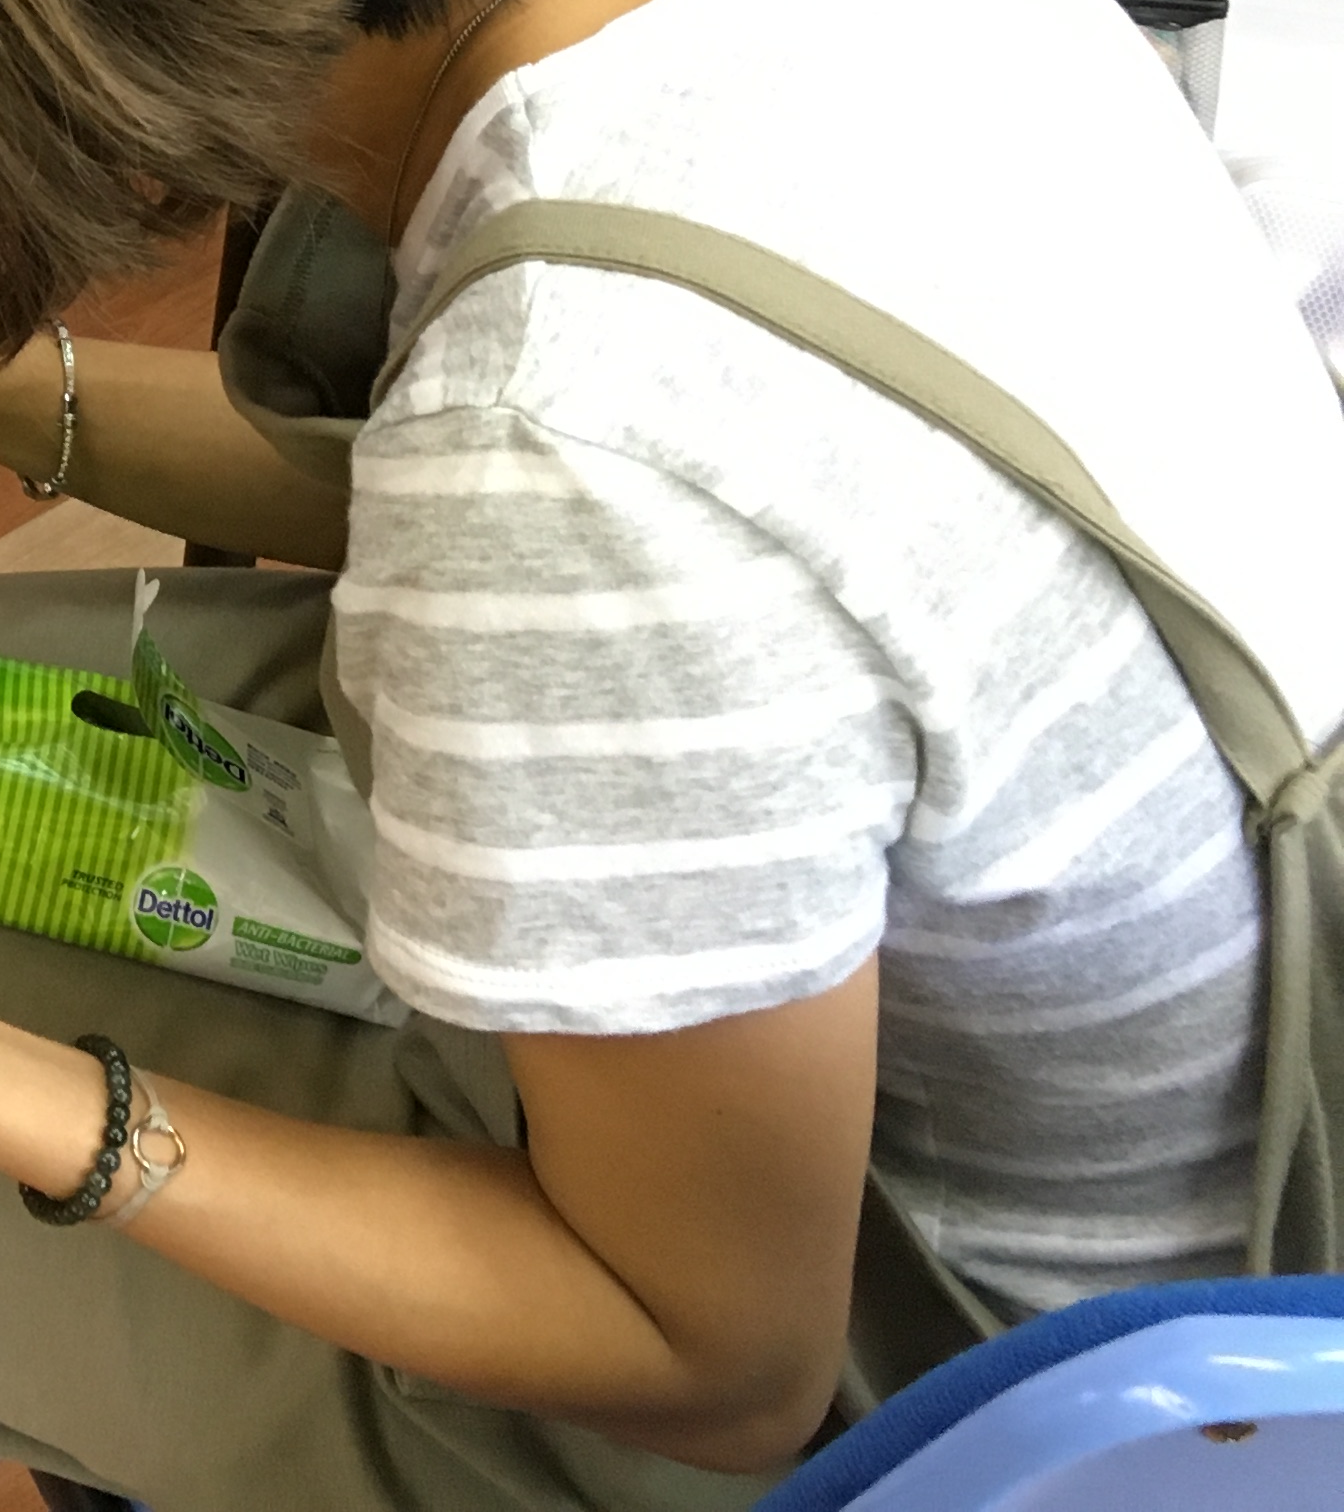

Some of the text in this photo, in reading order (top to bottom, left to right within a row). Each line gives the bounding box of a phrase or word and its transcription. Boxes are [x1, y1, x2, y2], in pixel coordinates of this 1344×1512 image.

[60, 879, 123, 901] PROTECTION
[70, 869, 125, 890] TRUSTED
[137, 888, 215, 931] Dettol
[234, 940, 270, 963] Wet
[273, 946, 329, 975] Wipes
[237, 920, 352, 960] ANTI-BACTERIAL
